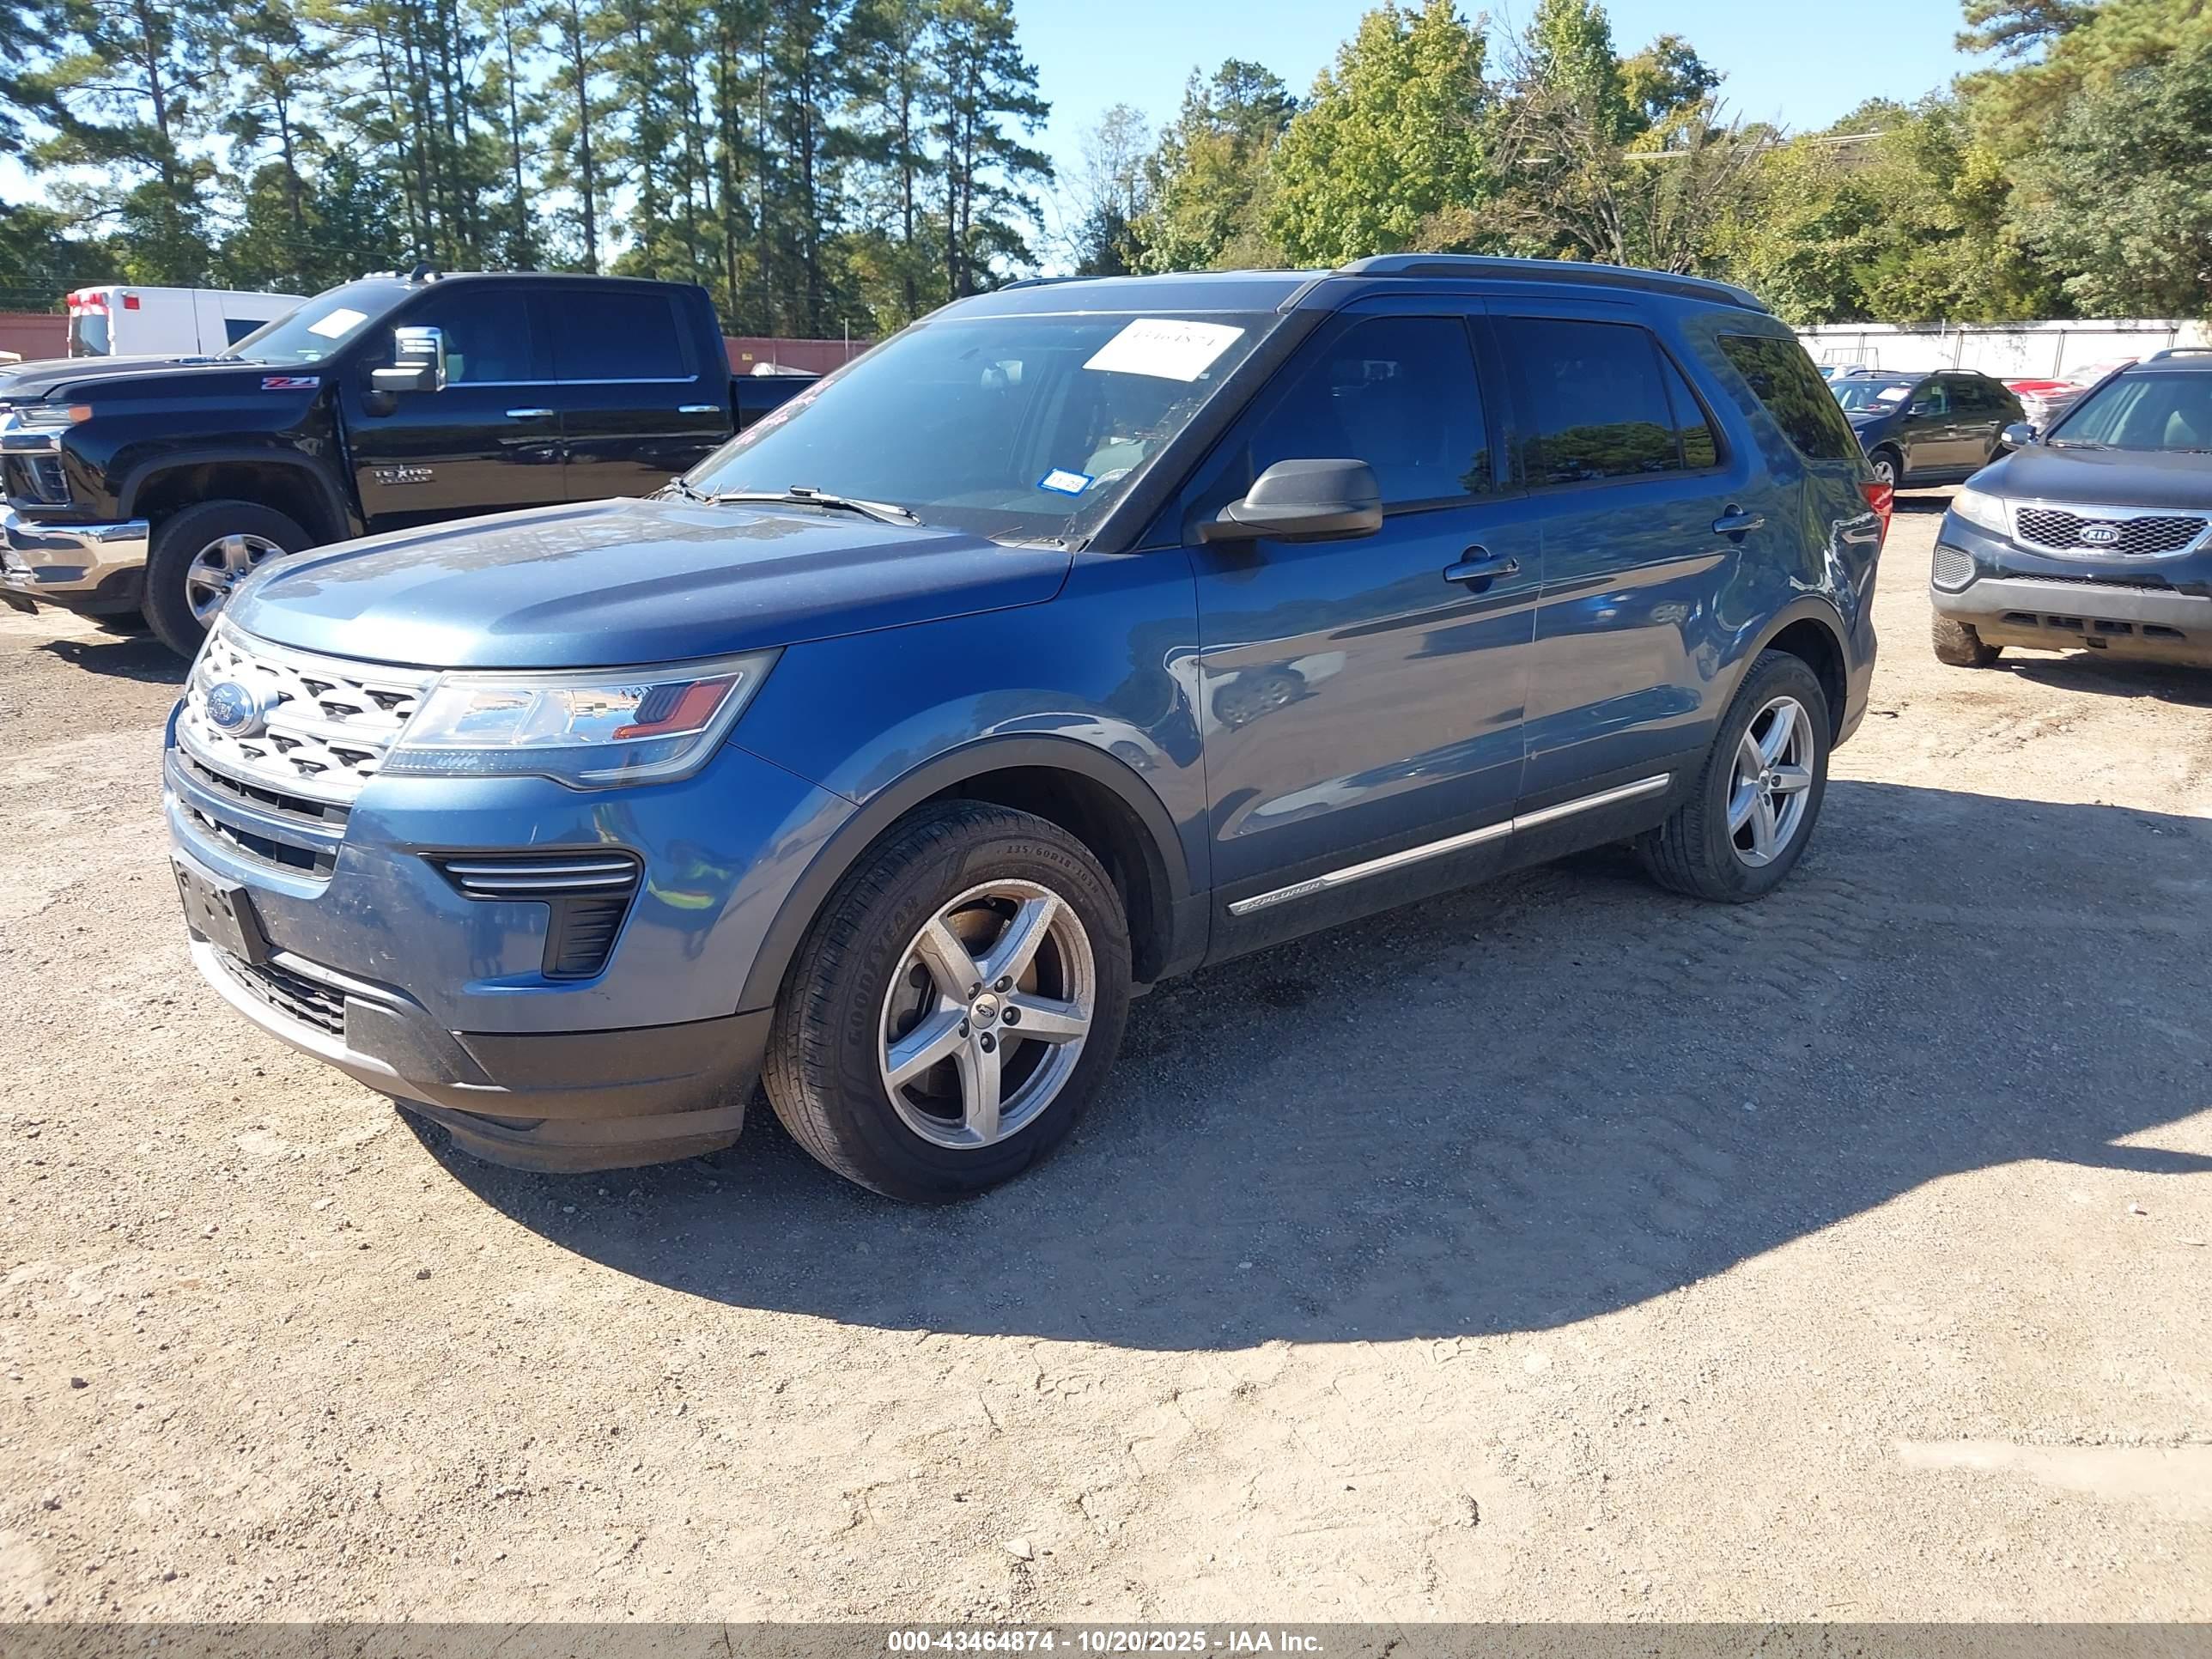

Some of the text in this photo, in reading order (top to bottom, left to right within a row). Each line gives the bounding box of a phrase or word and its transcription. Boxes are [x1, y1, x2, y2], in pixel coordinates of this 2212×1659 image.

[261, 376, 320, 391] Z71
[371, 464, 434, 478] TEXAS
[2087, 530, 2112, 541] KIA
[1237, 882, 1321, 912] EXPLORER
